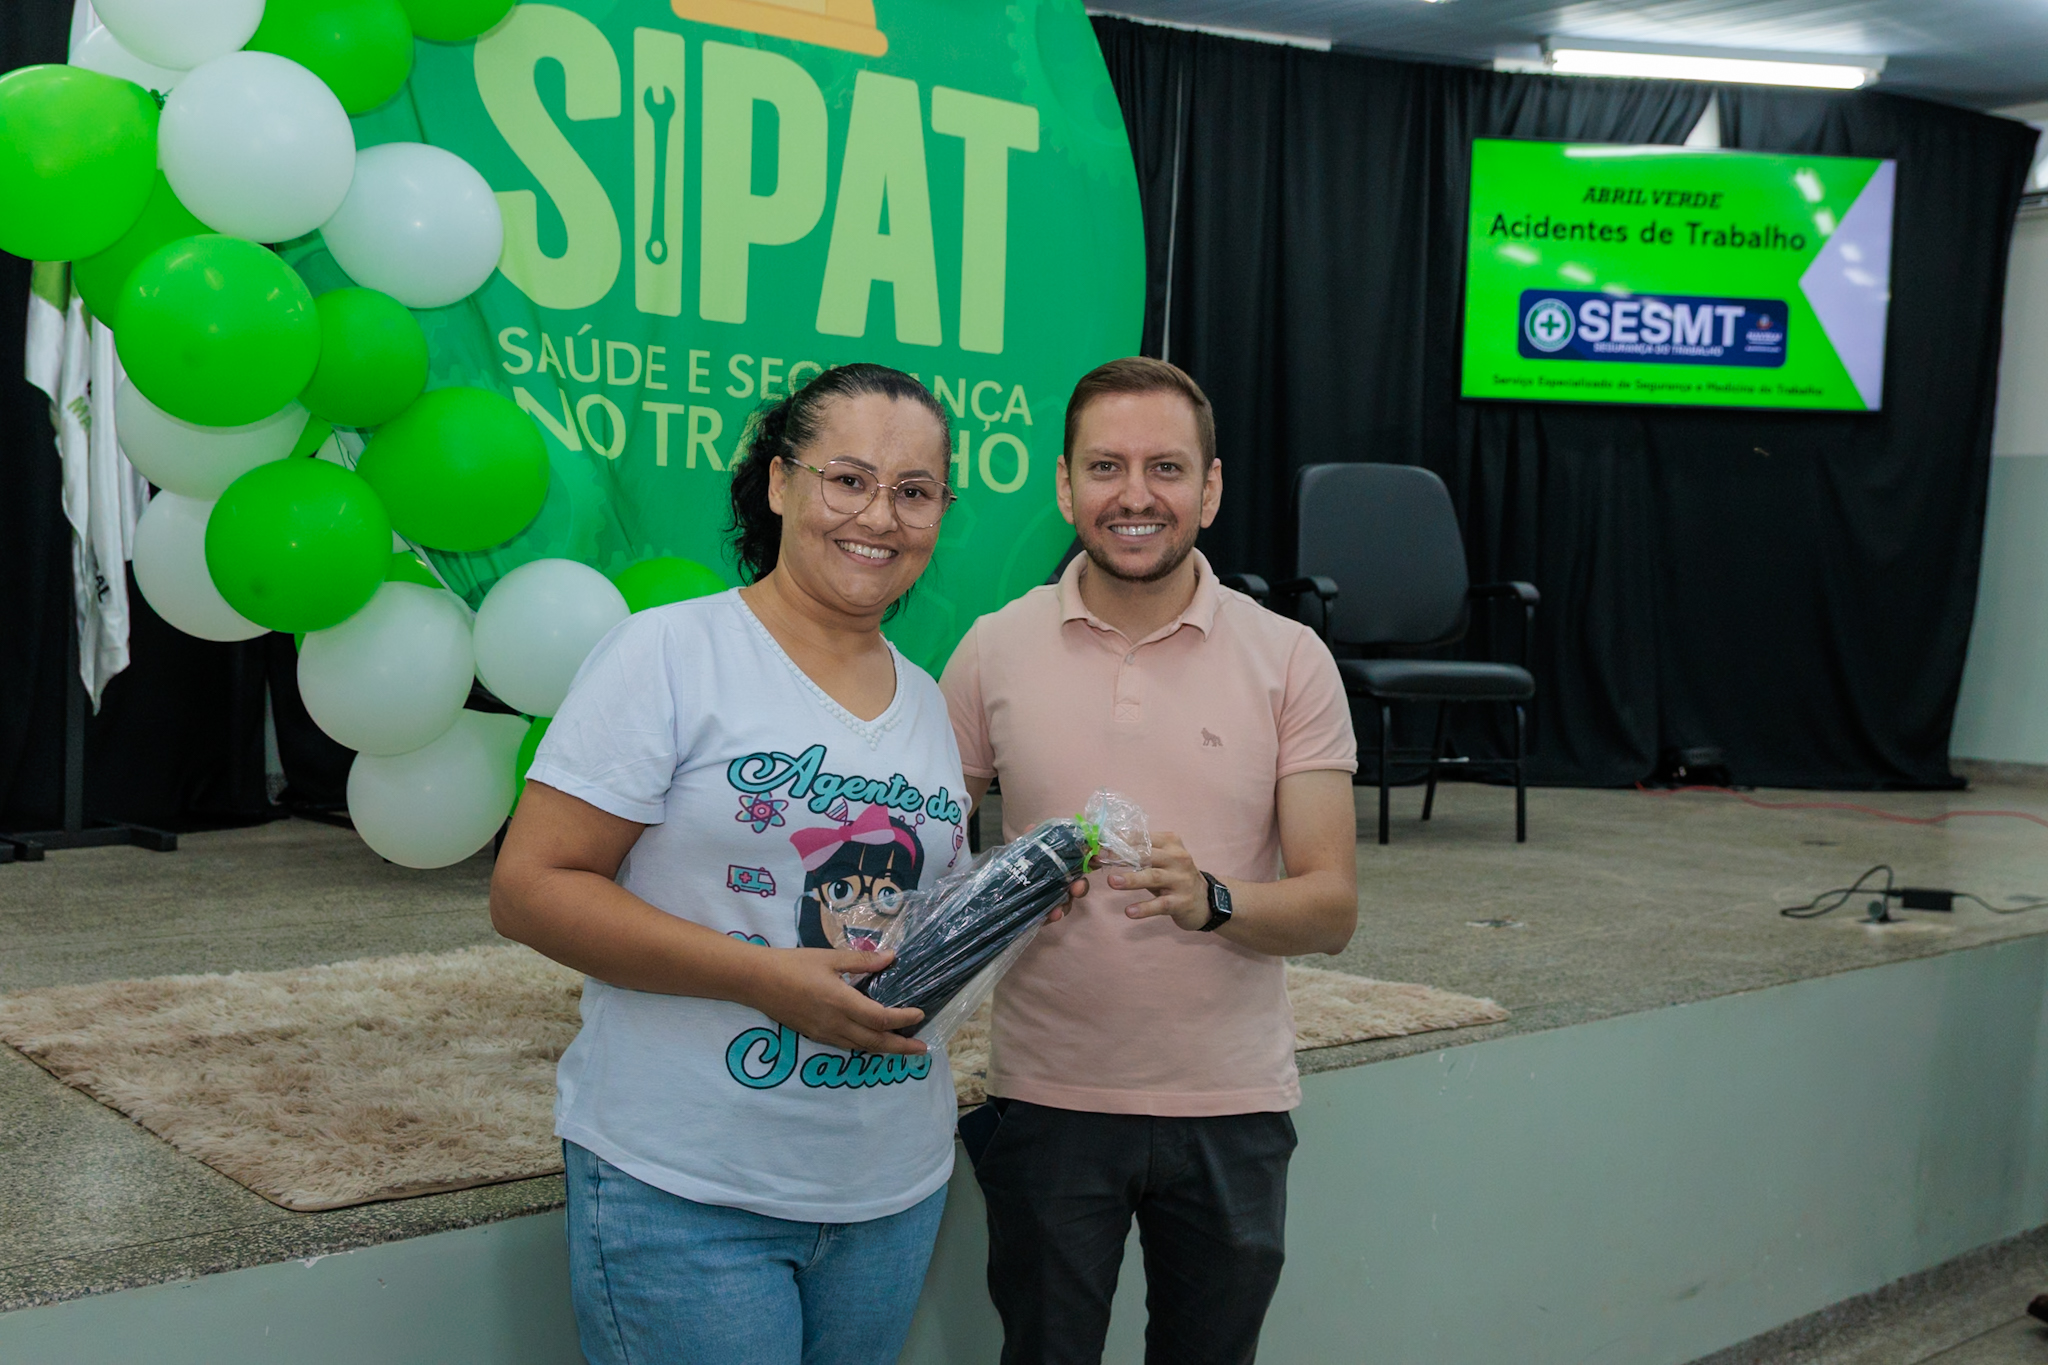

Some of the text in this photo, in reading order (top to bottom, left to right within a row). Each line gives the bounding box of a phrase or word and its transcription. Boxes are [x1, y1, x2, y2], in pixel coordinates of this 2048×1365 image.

[473, 3, 1040, 355] SIPAT
[1582, 186, 1725, 210] ABRIL VERDE
[1489, 213, 1807, 252] Acidentes de Trabalho
[1577, 300, 1747, 348] SESMT
[498, 324, 1033, 432] SAÚDE E SEGNÇA
[512, 384, 1029, 494] NO TRHO
[727, 744, 962, 825] Agente de
